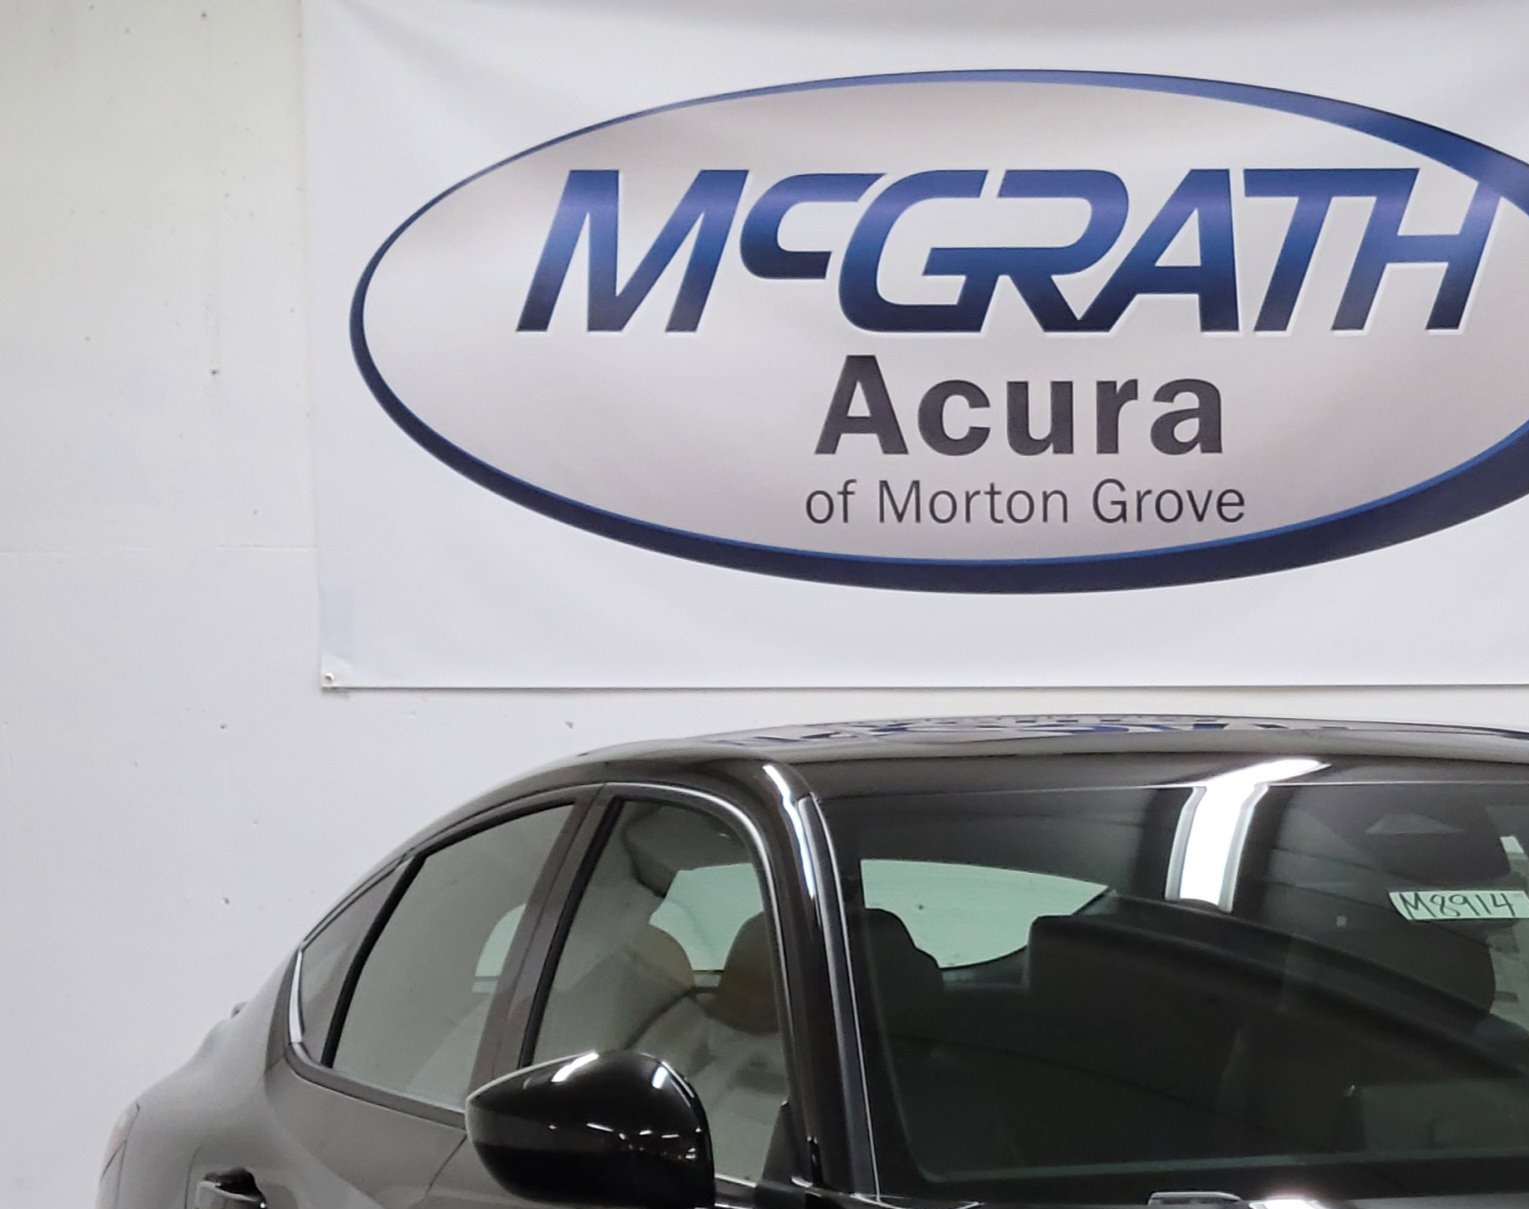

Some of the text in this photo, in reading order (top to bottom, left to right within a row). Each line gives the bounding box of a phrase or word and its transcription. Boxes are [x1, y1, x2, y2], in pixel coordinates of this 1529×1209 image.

[814, 355, 1224, 457] Acura
[805, 478, 1245, 524] of Morton Grove
[1398, 891, 1517, 919] M8914
